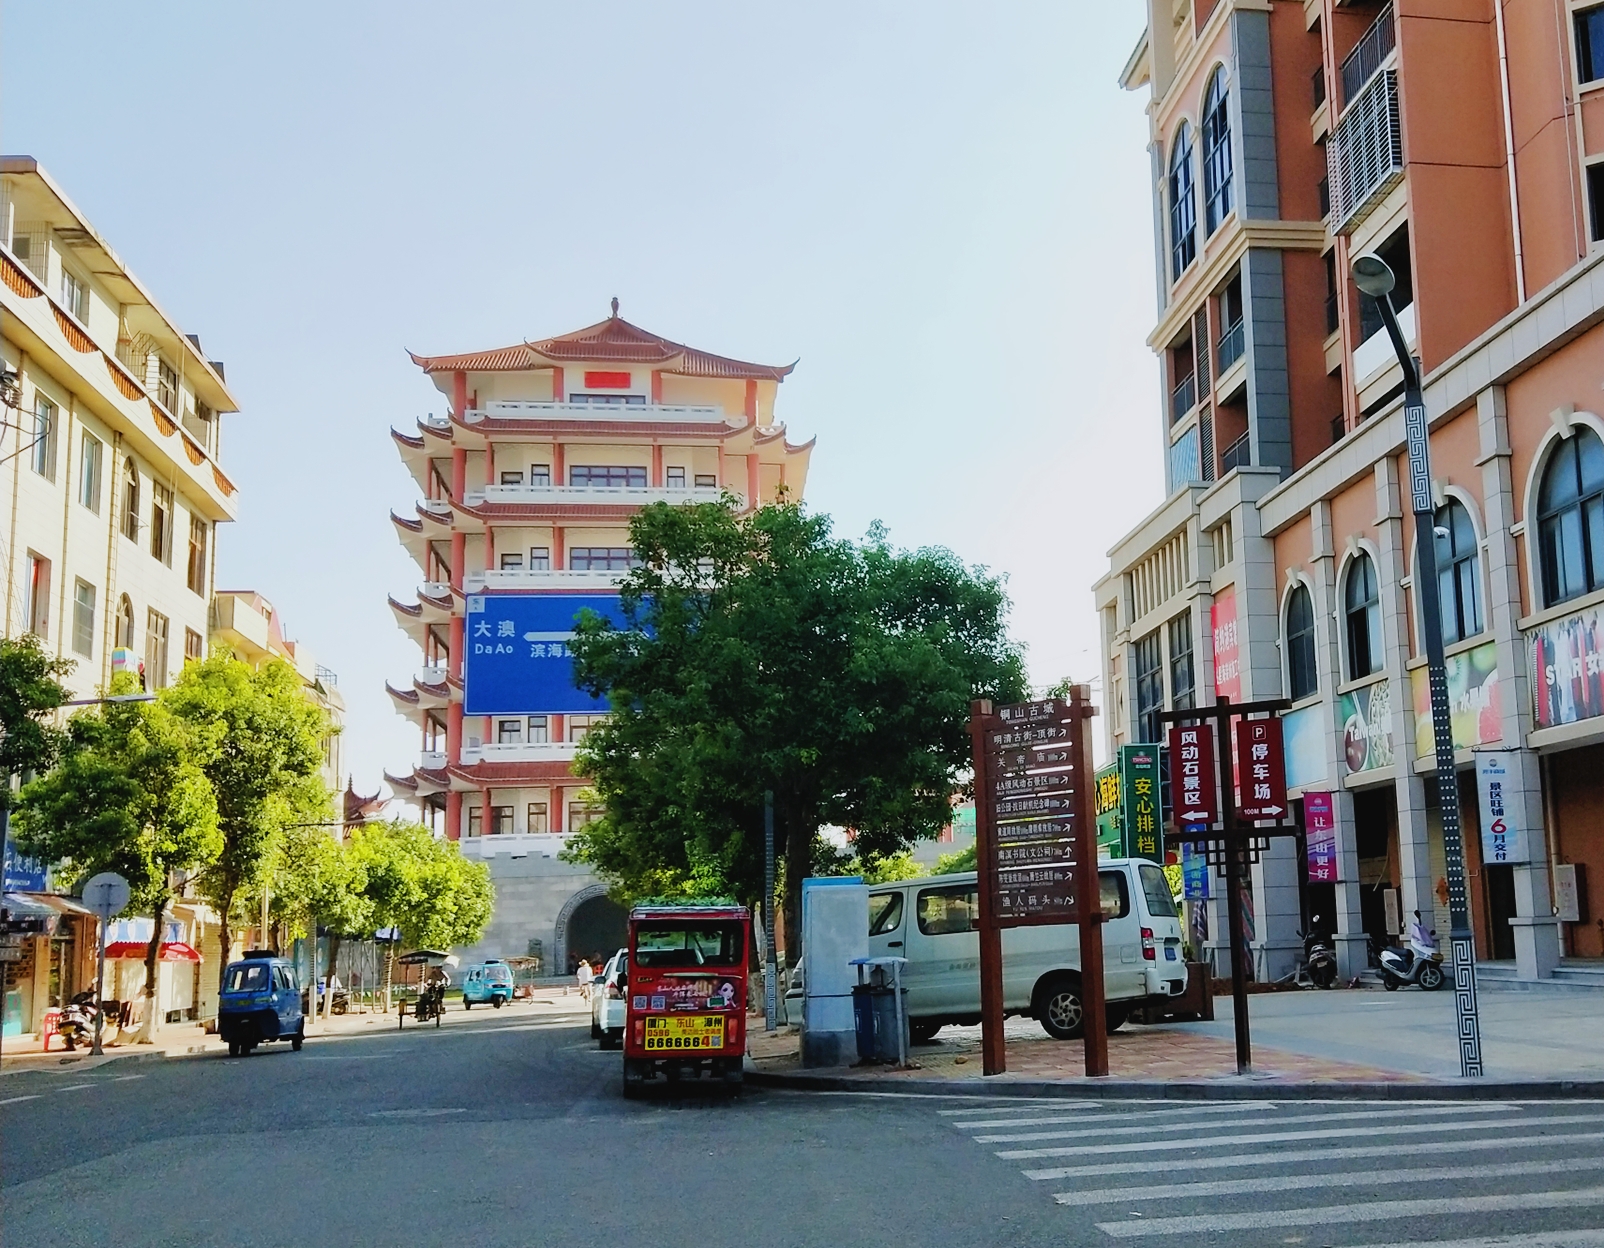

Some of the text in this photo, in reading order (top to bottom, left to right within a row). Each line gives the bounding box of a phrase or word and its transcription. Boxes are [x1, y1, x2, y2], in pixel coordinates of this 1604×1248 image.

[474, 620, 515, 638] 大澳
[1255, 727, 1264, 738] P
[1181, 731, 1201, 805] 风动石景区
[1252, 743, 1271, 800] 停车场
[1134, 777, 1155, 853] 安心排档
[1244, 808, 1260, 816] 100M
[1489, 782, 1508, 861] 景区旺铺6月交付
[676, 1017, 695, 1028] 东山
[647, 1036, 710, 1049] 6666664
